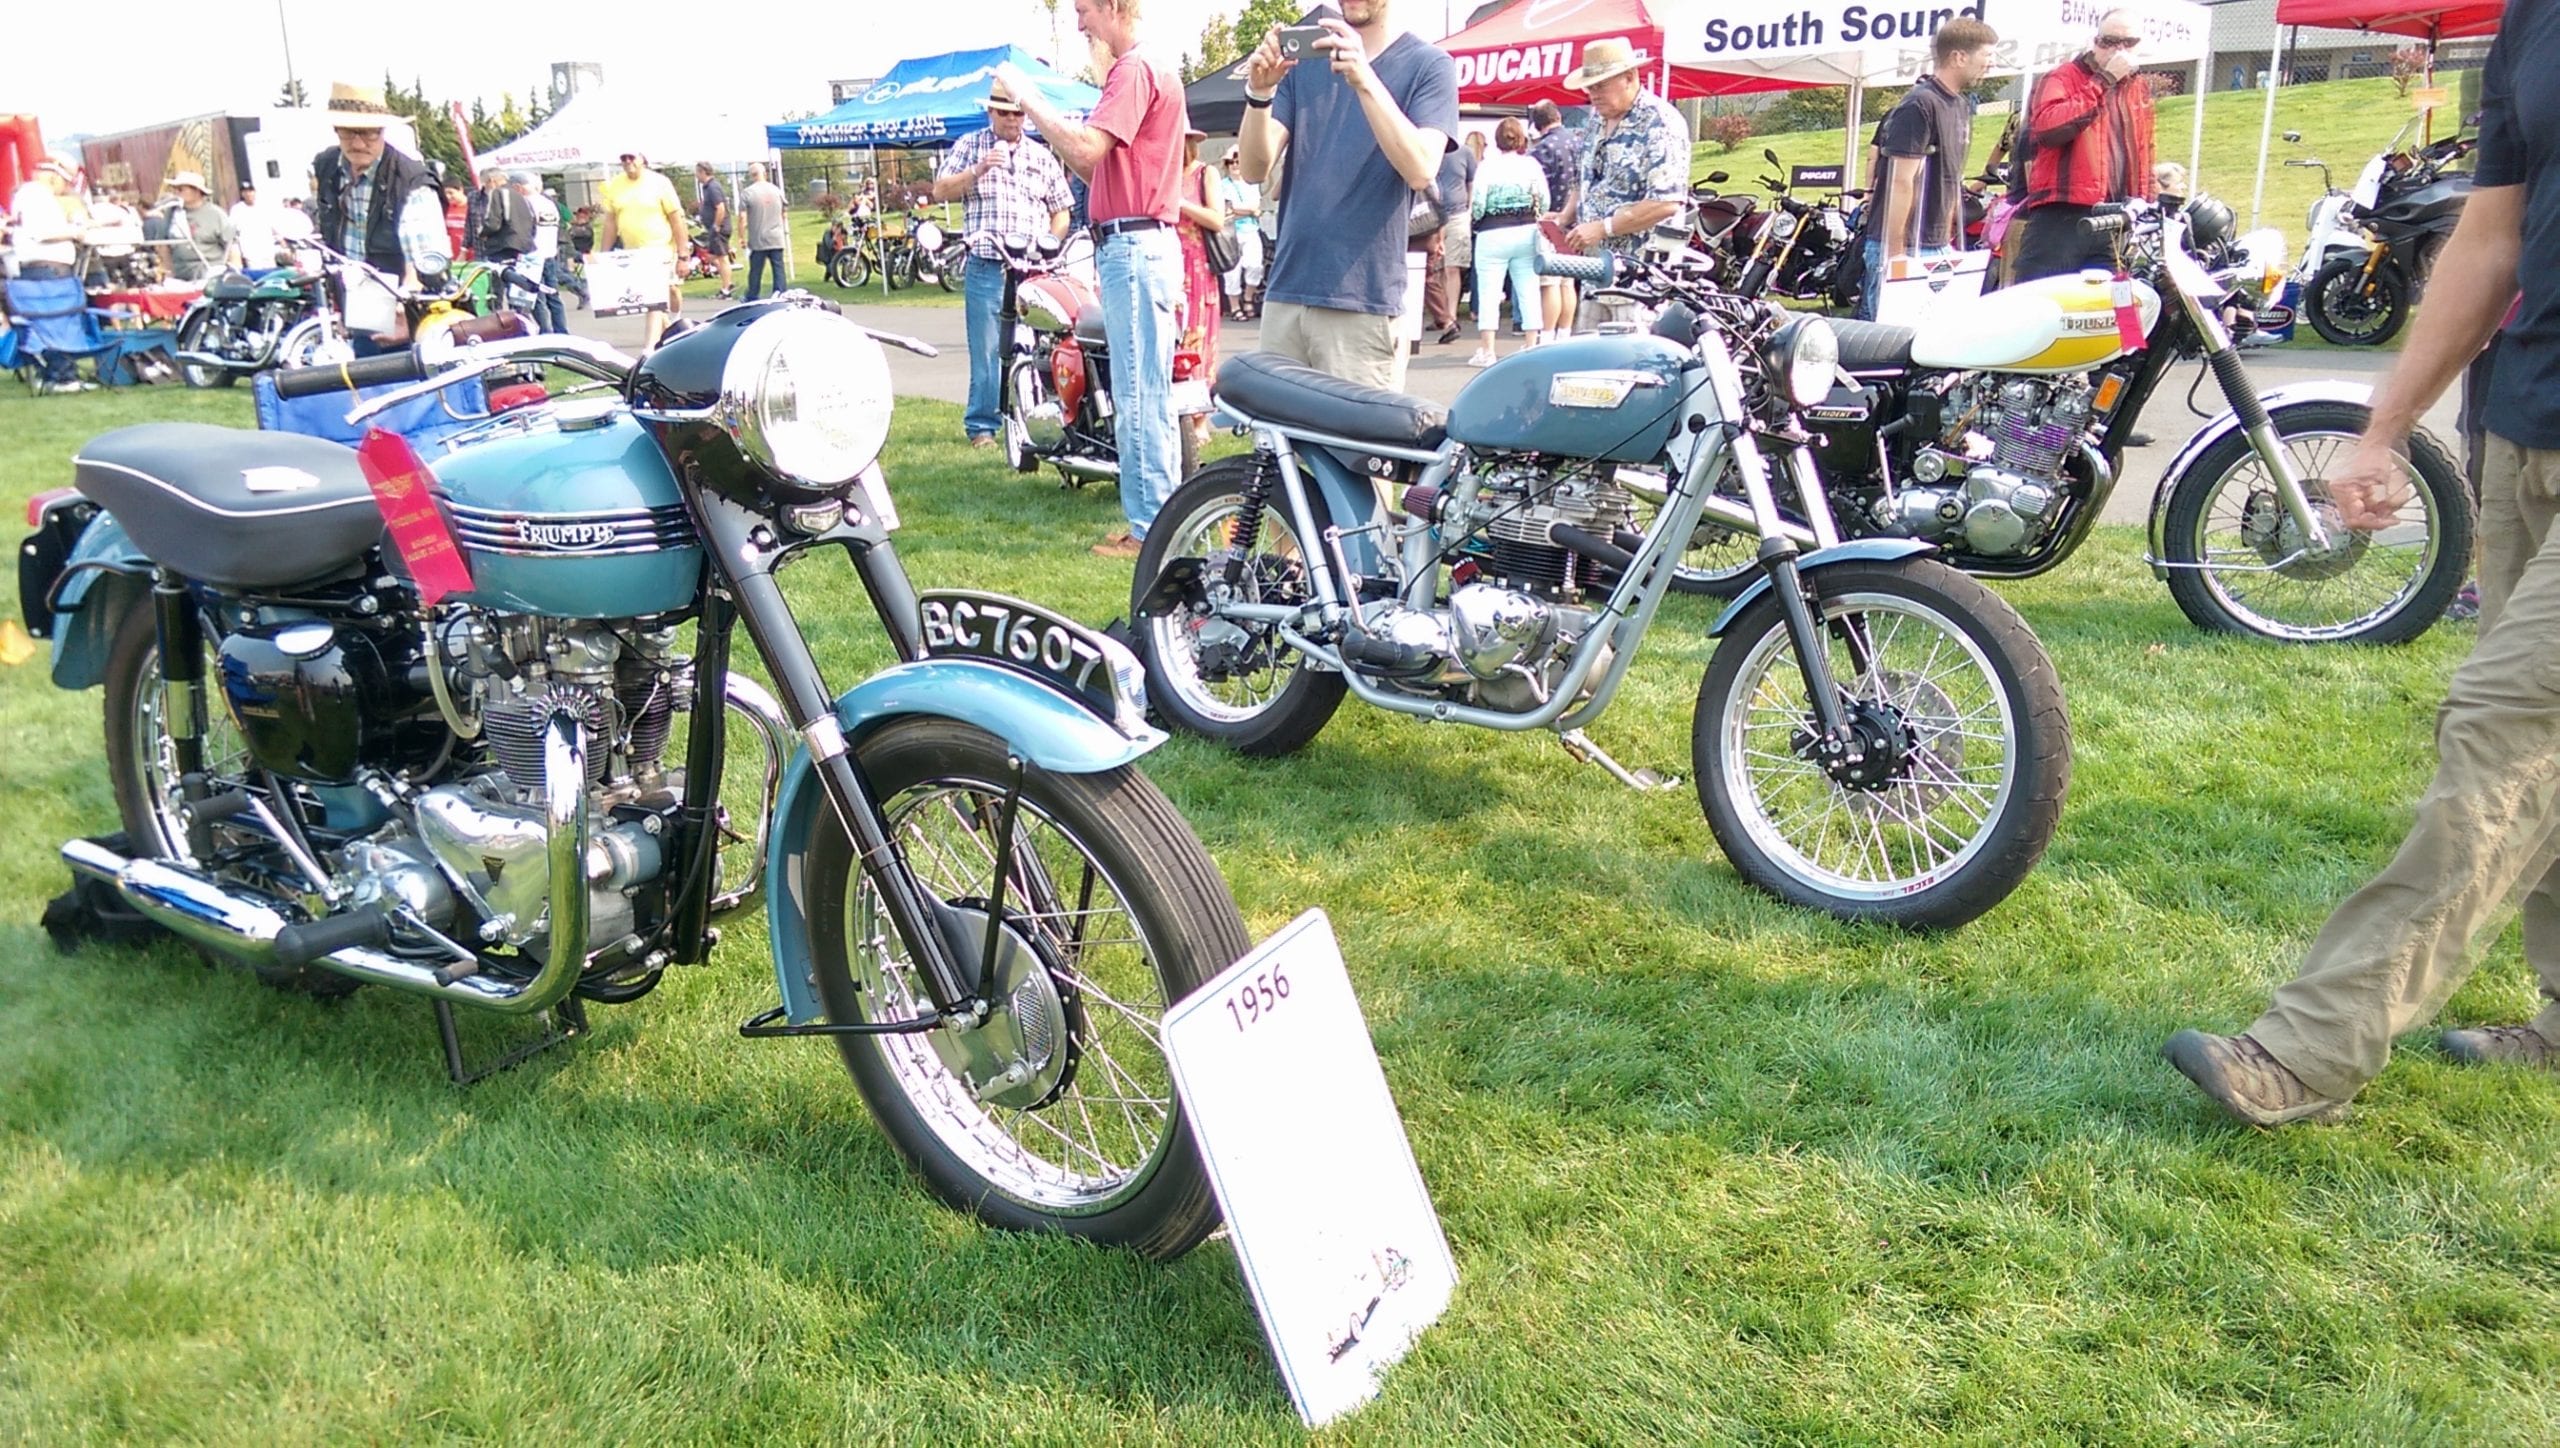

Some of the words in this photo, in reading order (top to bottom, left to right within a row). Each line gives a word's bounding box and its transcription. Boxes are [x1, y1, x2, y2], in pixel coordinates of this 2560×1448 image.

[1704, 11, 1824, 53] South
[1455, 41, 1574, 88] DUCATI
[1799, 171, 1838, 180] DUCATI
[2060, 315, 2117, 333] TRIUMP
[514, 519, 617, 550] TRIUMPH
[921, 600, 1102, 693] BC7607
[1226, 962, 1290, 1033] 1956
